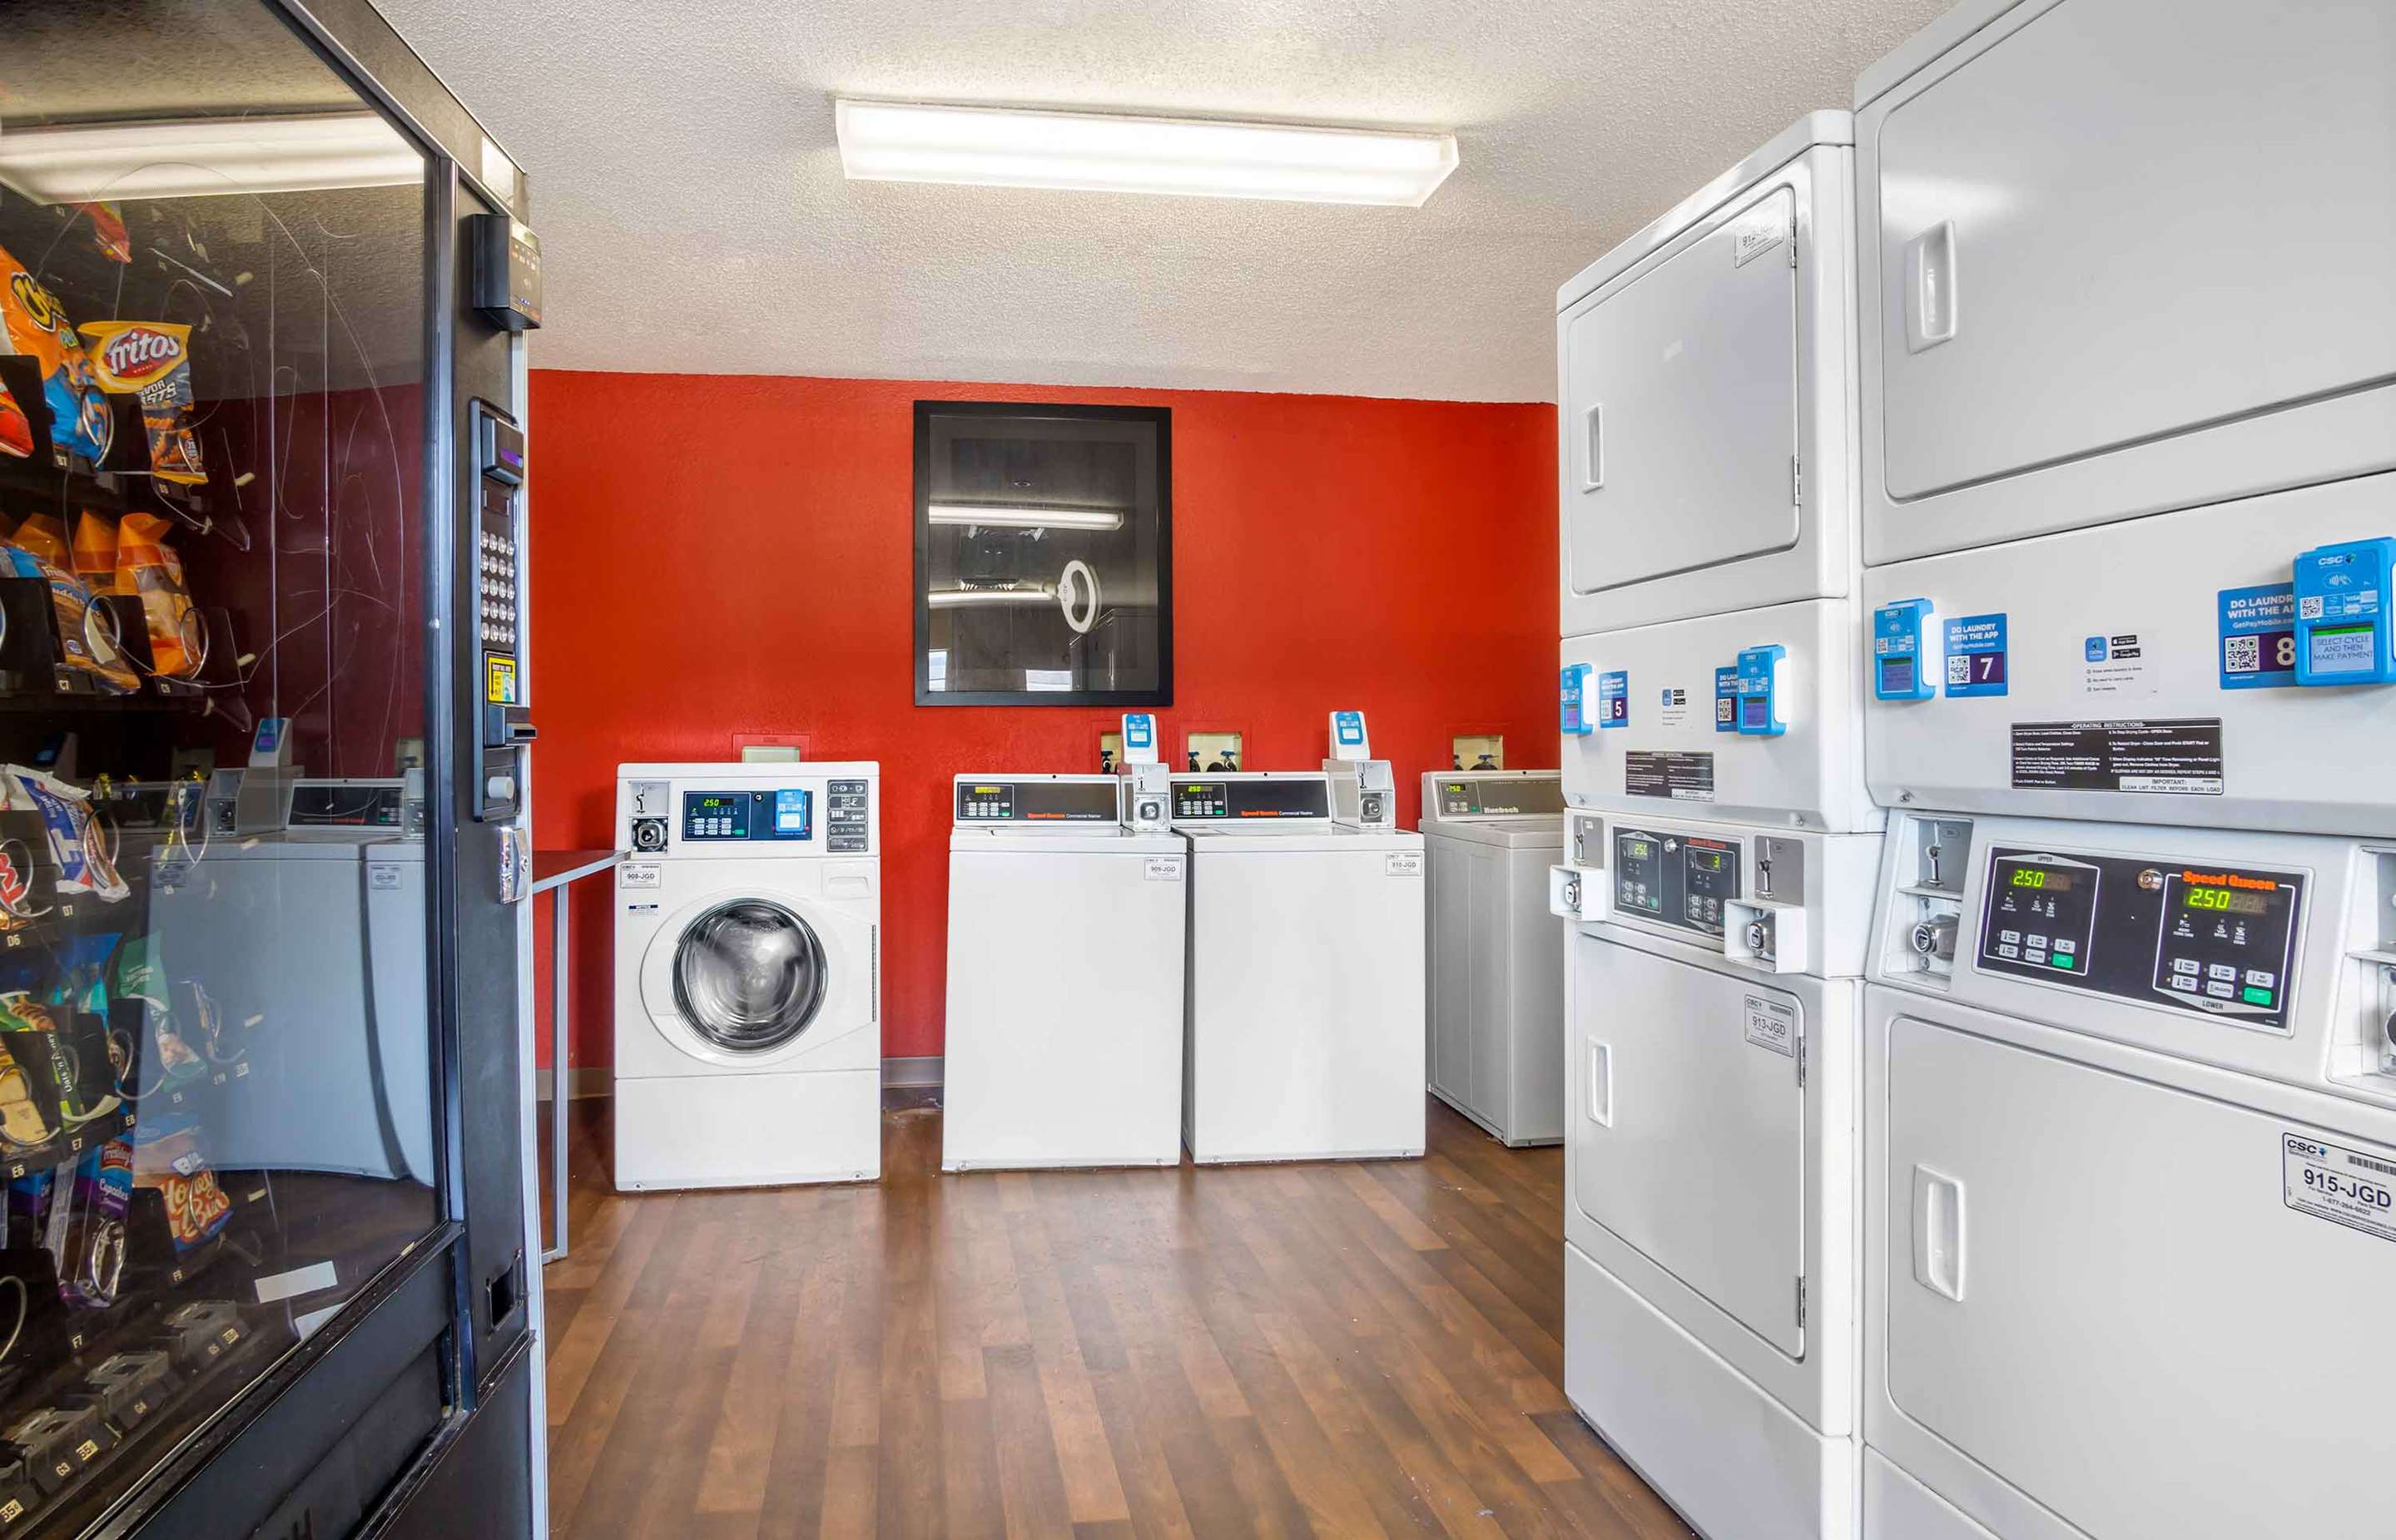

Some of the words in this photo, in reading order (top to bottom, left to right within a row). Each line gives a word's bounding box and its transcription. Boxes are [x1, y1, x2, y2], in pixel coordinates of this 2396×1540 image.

[107, 330, 180, 375] fritos
[2318, 555, 2344, 566] CSC
[2230, 599, 2247, 609] DO
[2249, 594, 2294, 607] LAUNDR
[2227, 609, 2255, 619] WITH
[2258, 606, 2279, 616] THE
[1963, 623, 1997, 632] LAUNDRY
[2232, 618, 2294, 629] GetPayMobile.co
[1949, 634, 1967, 642] WITH
[2276, 637, 2296, 666] 8
[1980, 657, 1994, 680] 7
[1615, 701, 1622, 716] 5
[2013, 869, 2045, 888] 2.50
[2182, 870, 2227, 885] Speed
[2228, 874, 2276, 891] Queen
[2188, 888, 2230, 909] 2.50
[7, 934, 22, 947] D6
[2202, 1000, 2224, 1010] LOWER
[1752, 1015, 1786, 1036] 913-JGD
[2287, 1139, 2318, 1154] CSC
[2304, 1169, 2392, 1207] 915-JGD
